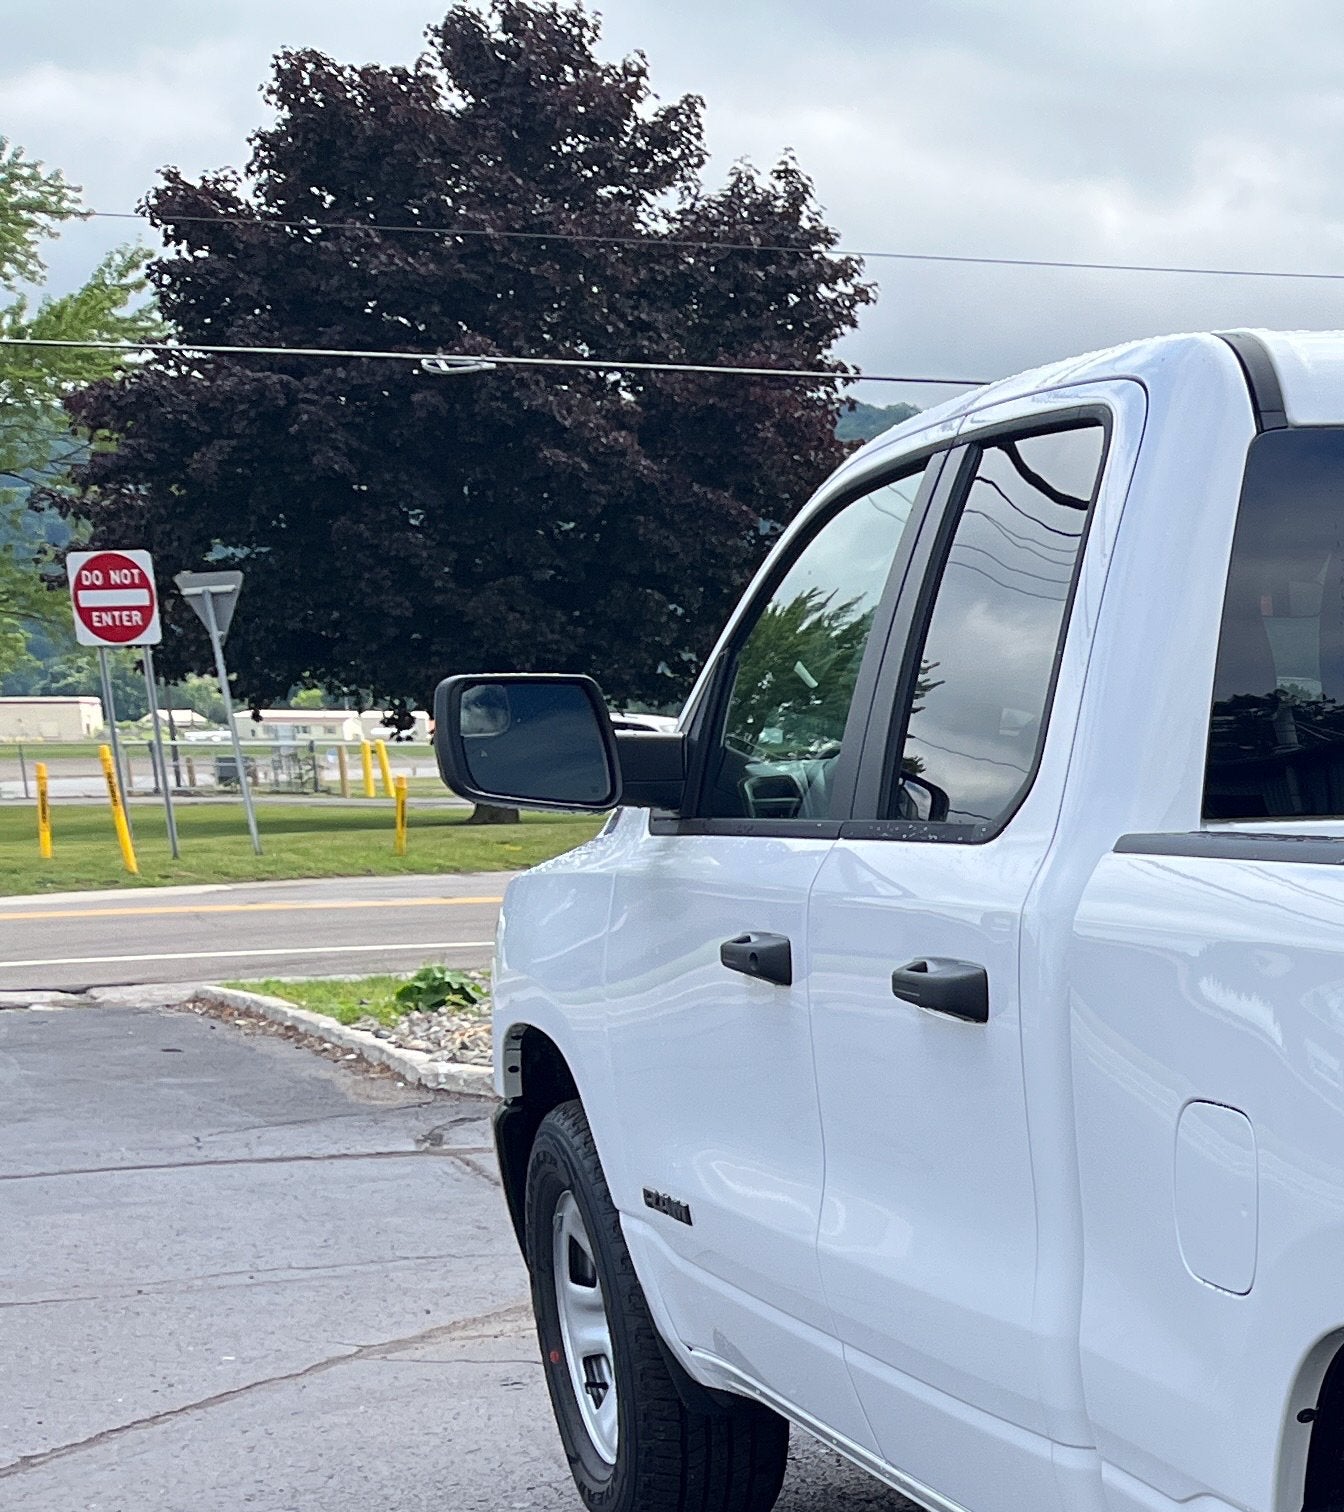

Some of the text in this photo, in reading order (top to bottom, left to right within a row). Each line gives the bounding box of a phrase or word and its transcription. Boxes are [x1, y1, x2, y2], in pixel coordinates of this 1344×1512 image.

[81, 568, 142, 586] DO NOT
[92, 611, 143, 627] ENTER
